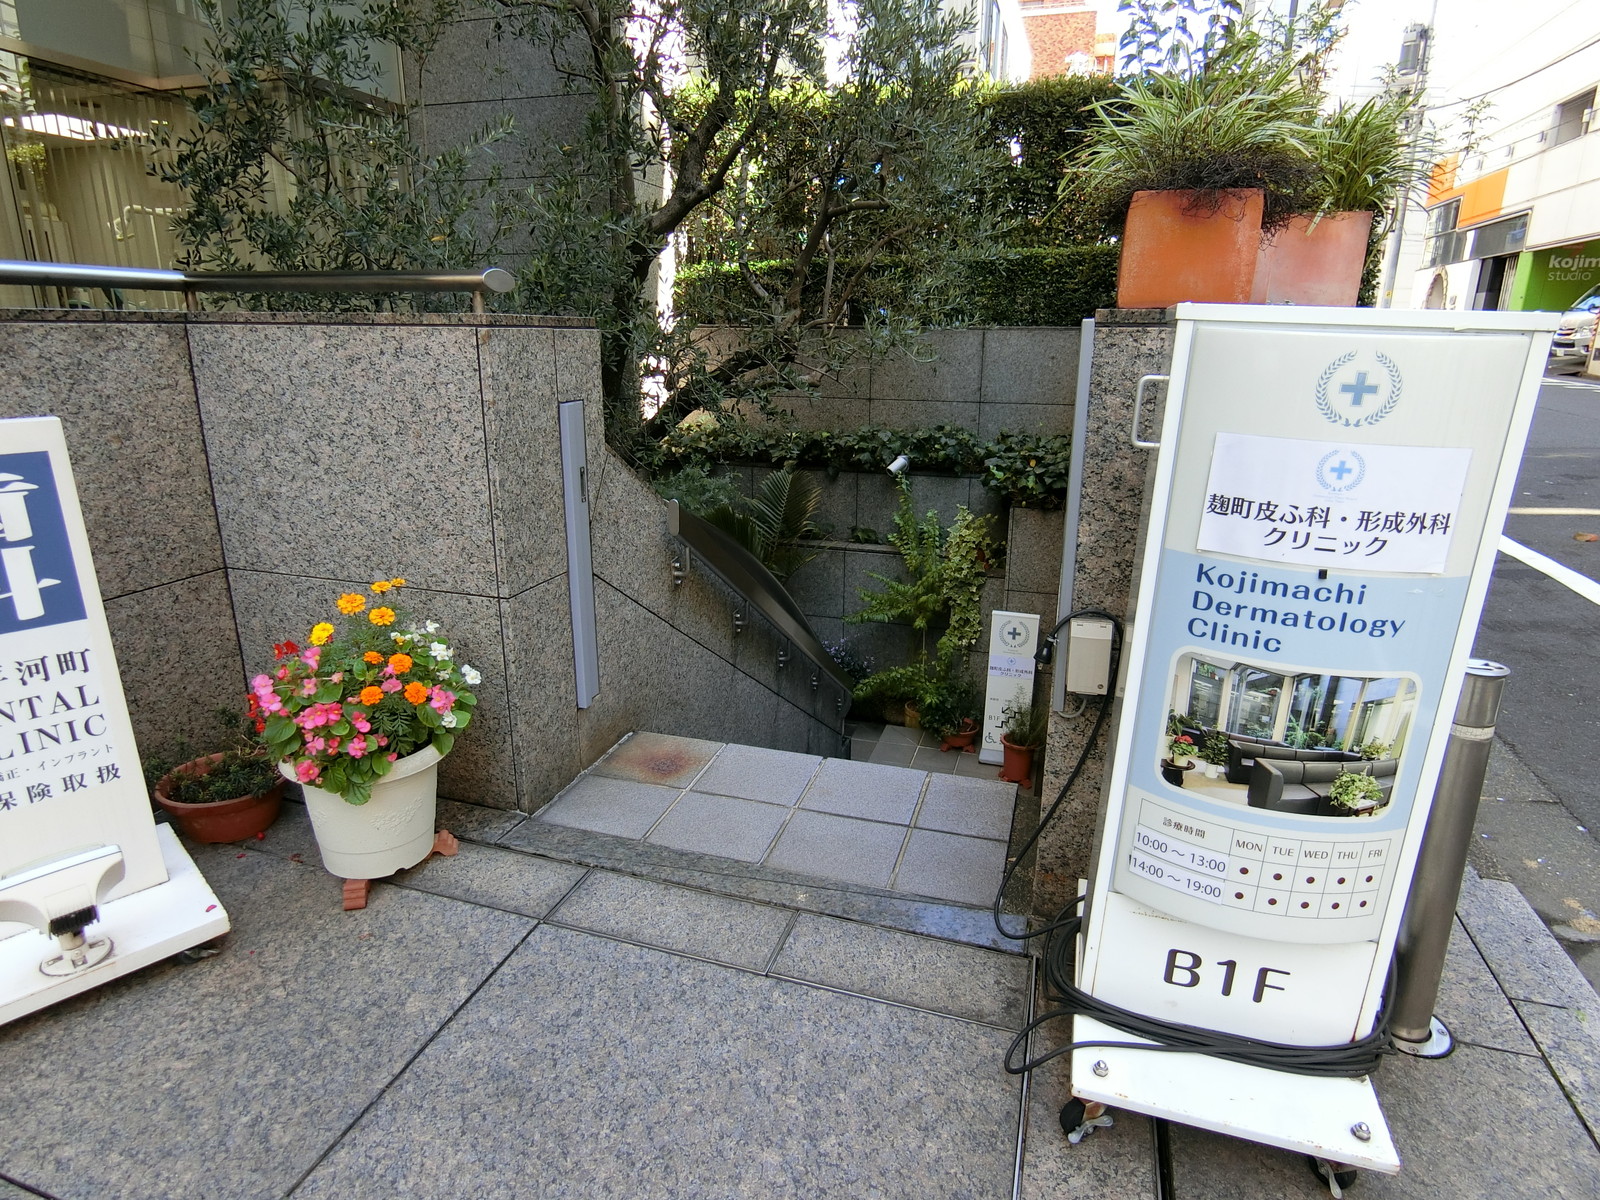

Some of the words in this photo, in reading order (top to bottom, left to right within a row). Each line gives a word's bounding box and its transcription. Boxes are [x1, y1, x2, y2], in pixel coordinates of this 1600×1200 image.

[1547, 269, 1592, 281] studio
[1206, 493, 1452, 536] 麹町皮ふ科・形成外科
[1263, 526, 1389, 557] クリニック
[1196, 562, 1367, 605] Kojimachi
[1192, 590, 1406, 638] Dermatology
[1187, 617, 1282, 653] Clinic
[0, 648, 91, 687] 河町
[1162, 816, 1206, 839] 診療時間
[1136, 832, 1169, 853] 10:00
[1190, 853, 1227, 873] 13:00
[1235, 839, 1263, 852] MON
[1272, 846, 1295, 857] TUE
[1304, 850, 1329, 860] WED
[1337, 851, 1359, 860] THU
[1368, 848, 1383, 859] FRI
[1132, 857, 1164, 879] 14:00
[1186, 878, 1221, 898] 19:00
[1163, 948, 1292, 1003] B1F
